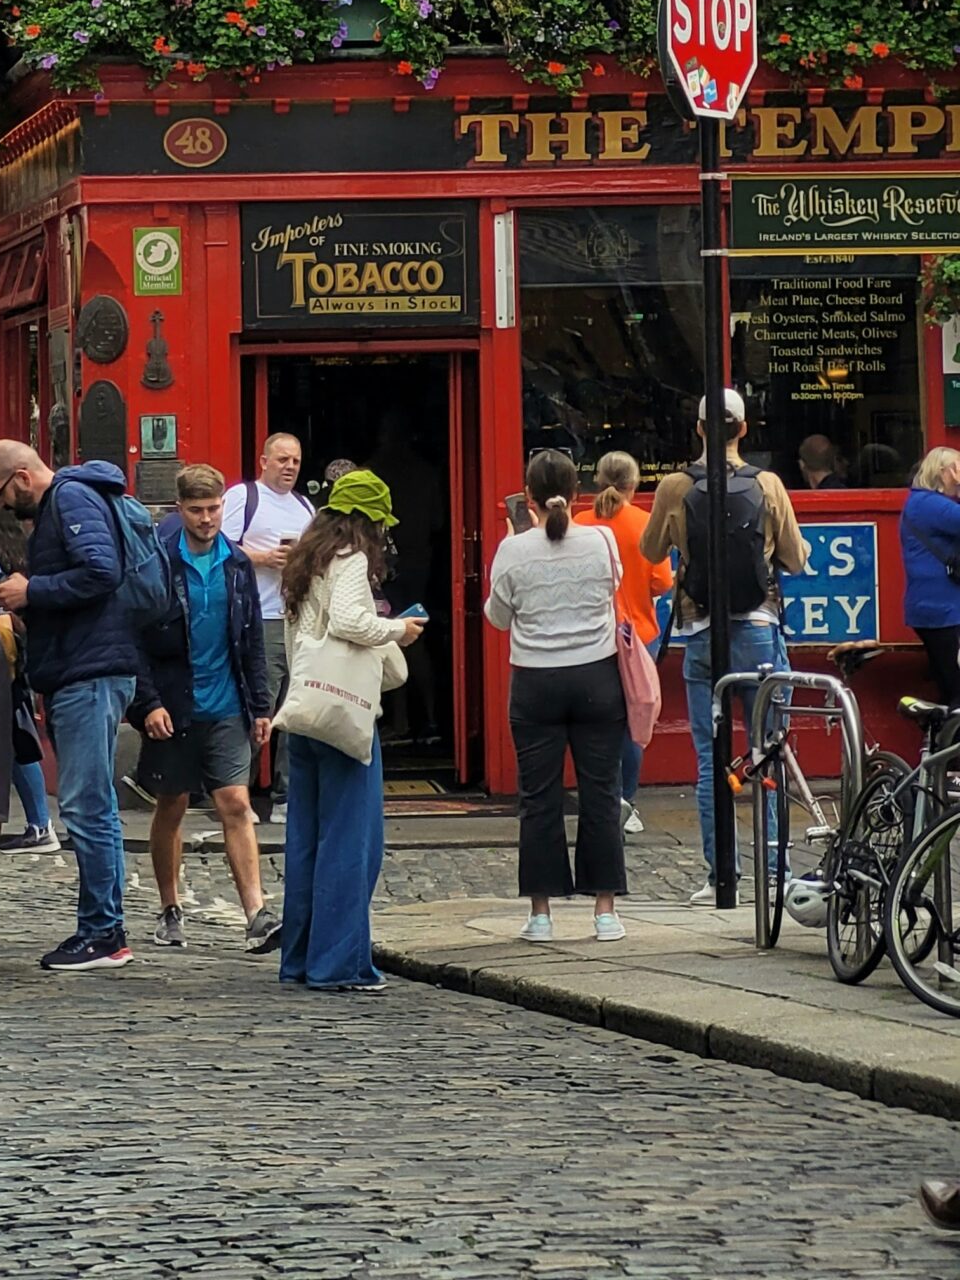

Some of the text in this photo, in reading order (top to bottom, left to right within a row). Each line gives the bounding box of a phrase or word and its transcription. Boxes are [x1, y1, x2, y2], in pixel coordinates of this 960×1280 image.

[174, 126, 214, 155] 48
[460, 111, 651, 162] THE
[752, 193, 780, 217] The
[780, 183, 879, 227] Whiskey
[251, 213, 343, 252] Importers
[759, 232, 811, 242] IRELAND'S
[814, 232, 858, 241] LARGEST
[862, 231, 908, 241] WHISKEY
[309, 235, 326, 246] OF
[334, 241, 442, 257] FINE SMOKING
[145, 273, 172, 282] Official
[276, 252, 444, 307] TOBACCO
[771, 277, 892, 290] Traditional Food Fare
[143, 281, 175, 290] Member
[312, 296, 459, 313] Always in Stock
[760, 293, 903, 307] Meat Plate, Cheese Board
[773, 312, 818, 326] Oysters,
[822, 311, 867, 323] Smoked
[754, 327, 898, 341] Charcuterie Meats, Olives
[770, 343, 882, 357] Toasted Sandwiches
[768, 361, 789, 374] Hot
[793, 359, 824, 373] Roast
[856, 360, 886, 371] Rolls
[832, 383, 855, 391] Times
